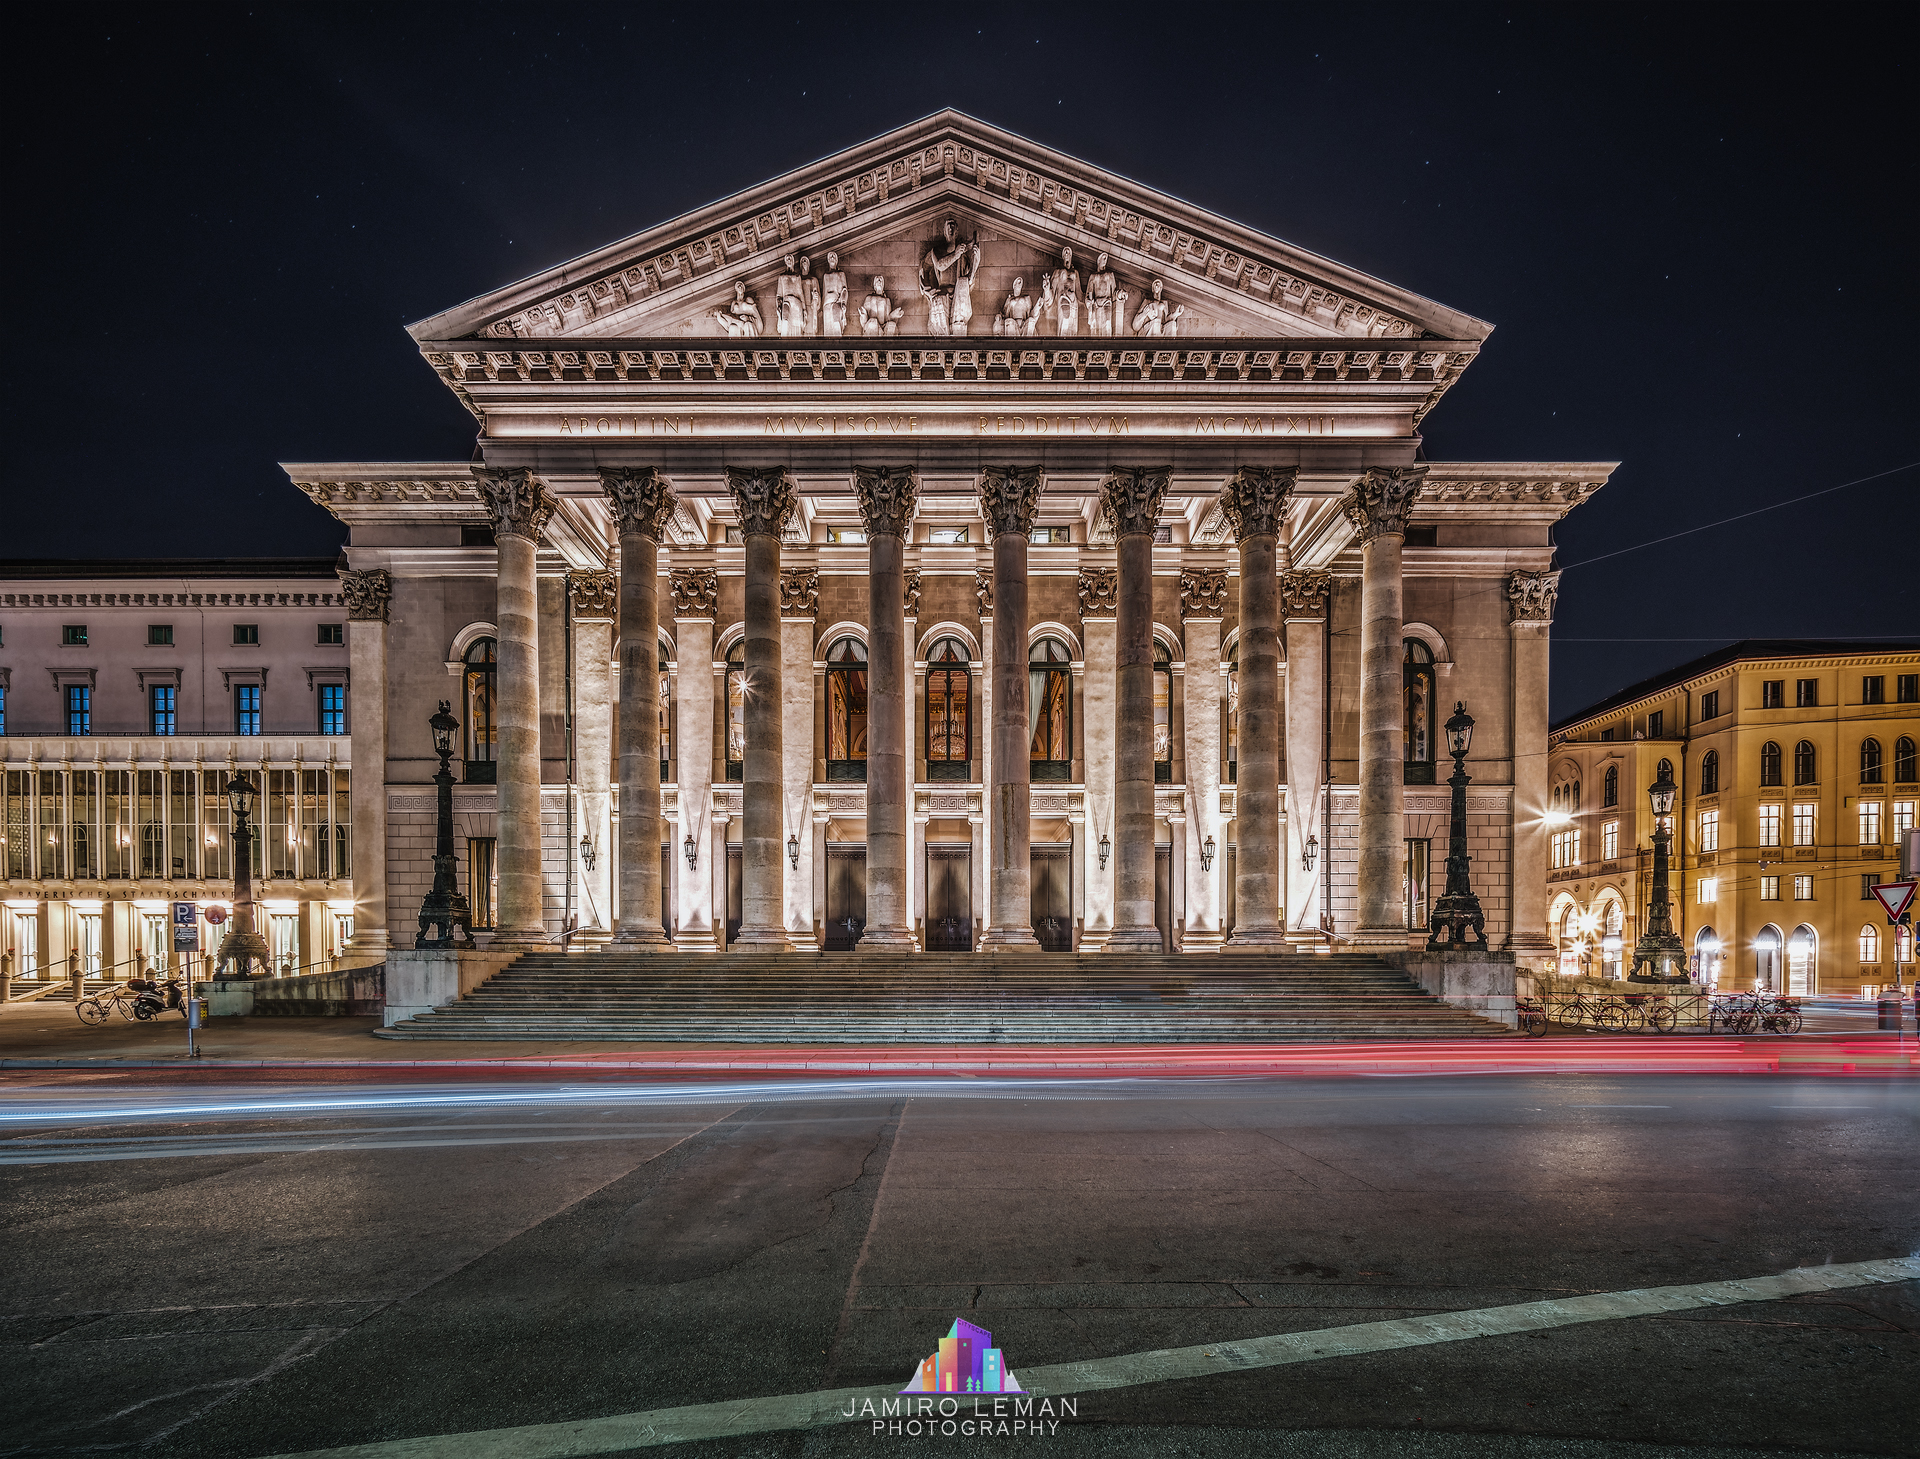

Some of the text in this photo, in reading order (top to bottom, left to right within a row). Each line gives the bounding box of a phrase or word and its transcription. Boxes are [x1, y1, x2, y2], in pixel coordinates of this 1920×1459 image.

[764, 416, 919, 434] MVSISQVE
[979, 416, 1130, 434] REDDITVM
[18, 890, 262, 899] BAYERISCHES STAATSSCHAUSL
[176, 904, 190, 922] P
